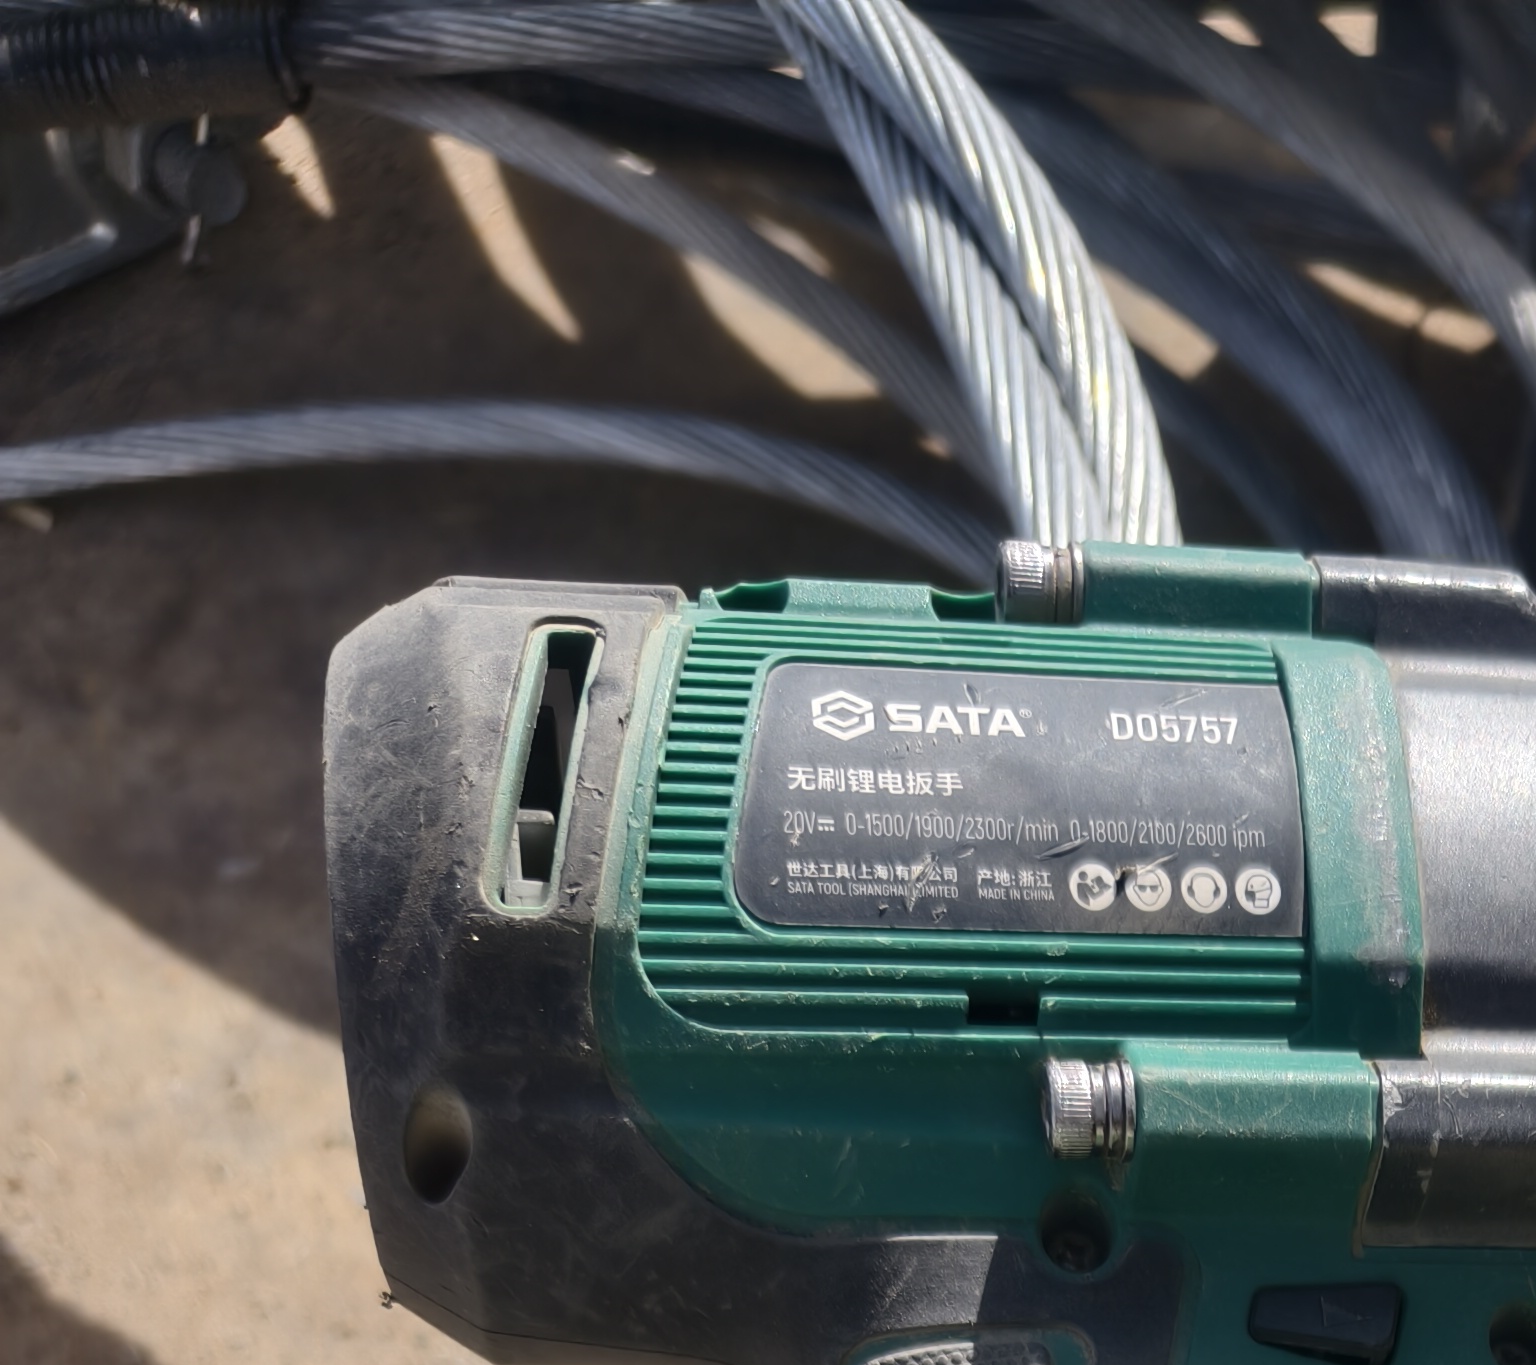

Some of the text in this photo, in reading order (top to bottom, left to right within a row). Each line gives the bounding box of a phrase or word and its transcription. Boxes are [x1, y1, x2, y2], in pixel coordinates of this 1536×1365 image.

[786, 765, 964, 797] 无刷锂电扳手
[787, 881, 816, 895] SATA
[817, 882, 847, 896] TOOL
[849, 882, 916, 898] (SHANGHAI
[978, 888, 1055, 901] MADE IN CHINA
